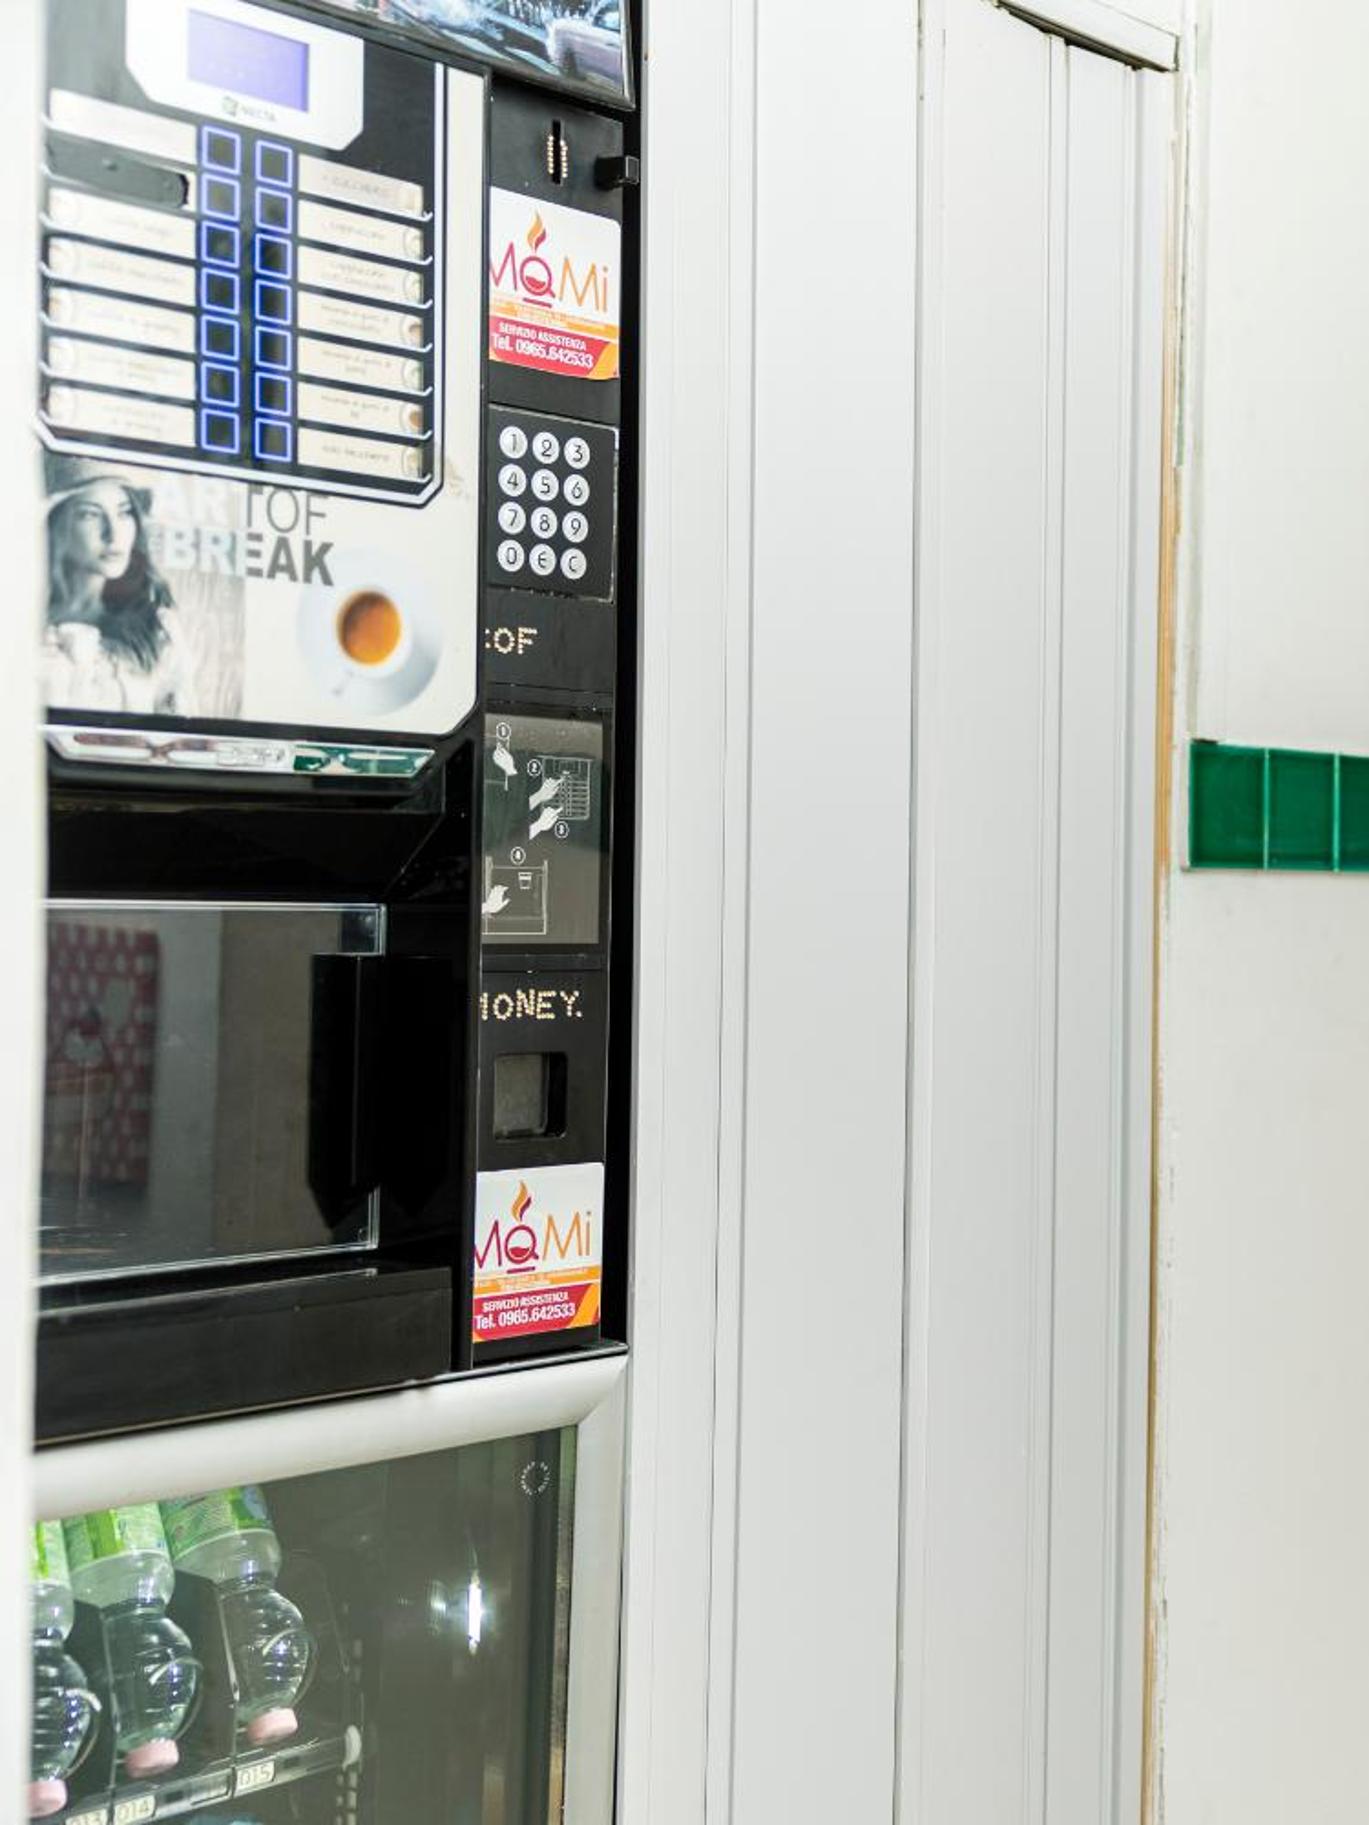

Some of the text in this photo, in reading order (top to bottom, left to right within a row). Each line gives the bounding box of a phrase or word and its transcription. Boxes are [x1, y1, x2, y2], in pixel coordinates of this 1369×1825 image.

[541, 439, 552, 457] 2
[572, 445, 583, 463] 3
[506, 471, 519, 491] 4
[540, 476, 550, 495] 5
[571, 481, 583, 499] 6
[507, 509, 518, 527] 7
[539, 514, 551, 532] 8
[570, 517, 582, 536] 9
[164, 522, 335, 588] BREAK
[568, 555, 578, 574] C
[475, 1302, 576, 1330] Tel. 0965.642533
